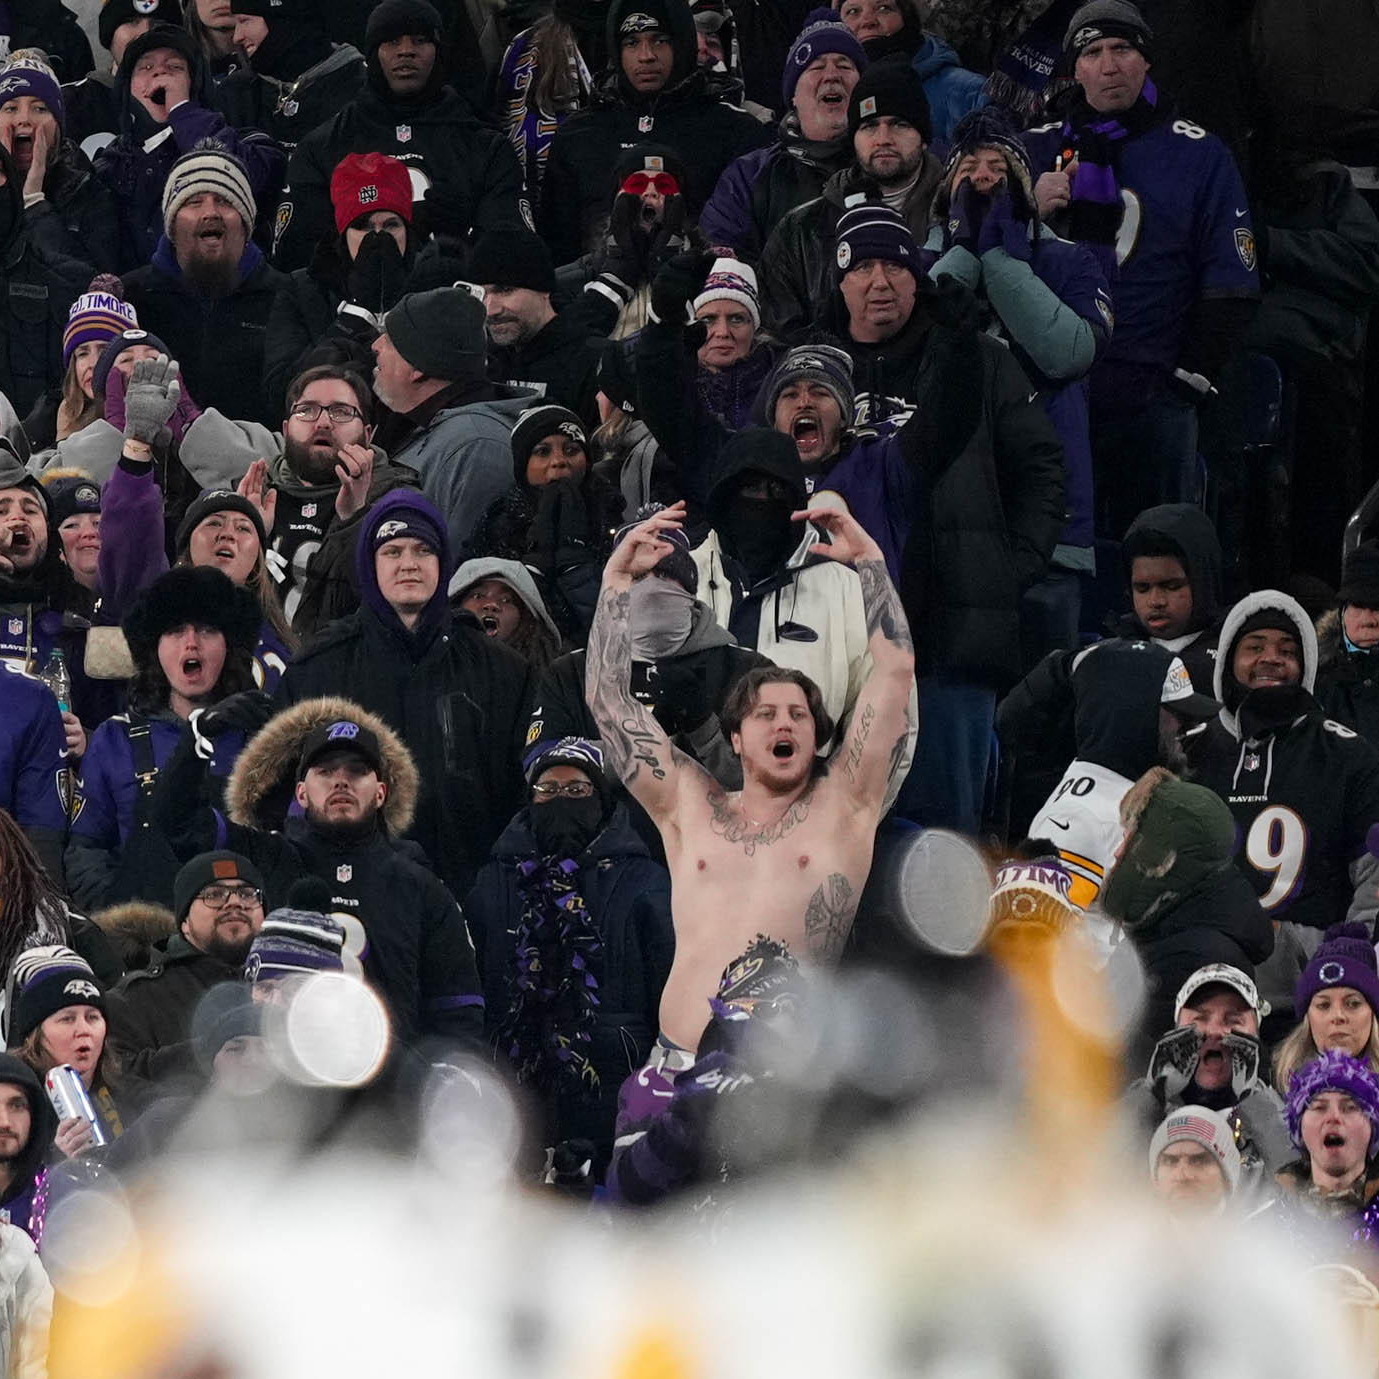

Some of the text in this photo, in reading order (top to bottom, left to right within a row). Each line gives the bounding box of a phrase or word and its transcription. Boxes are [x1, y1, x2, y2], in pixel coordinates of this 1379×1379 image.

[289, 523, 323, 537] RAVENS
[1228, 794, 1269, 803] RAVENS
[1246, 805, 1307, 909] 9
